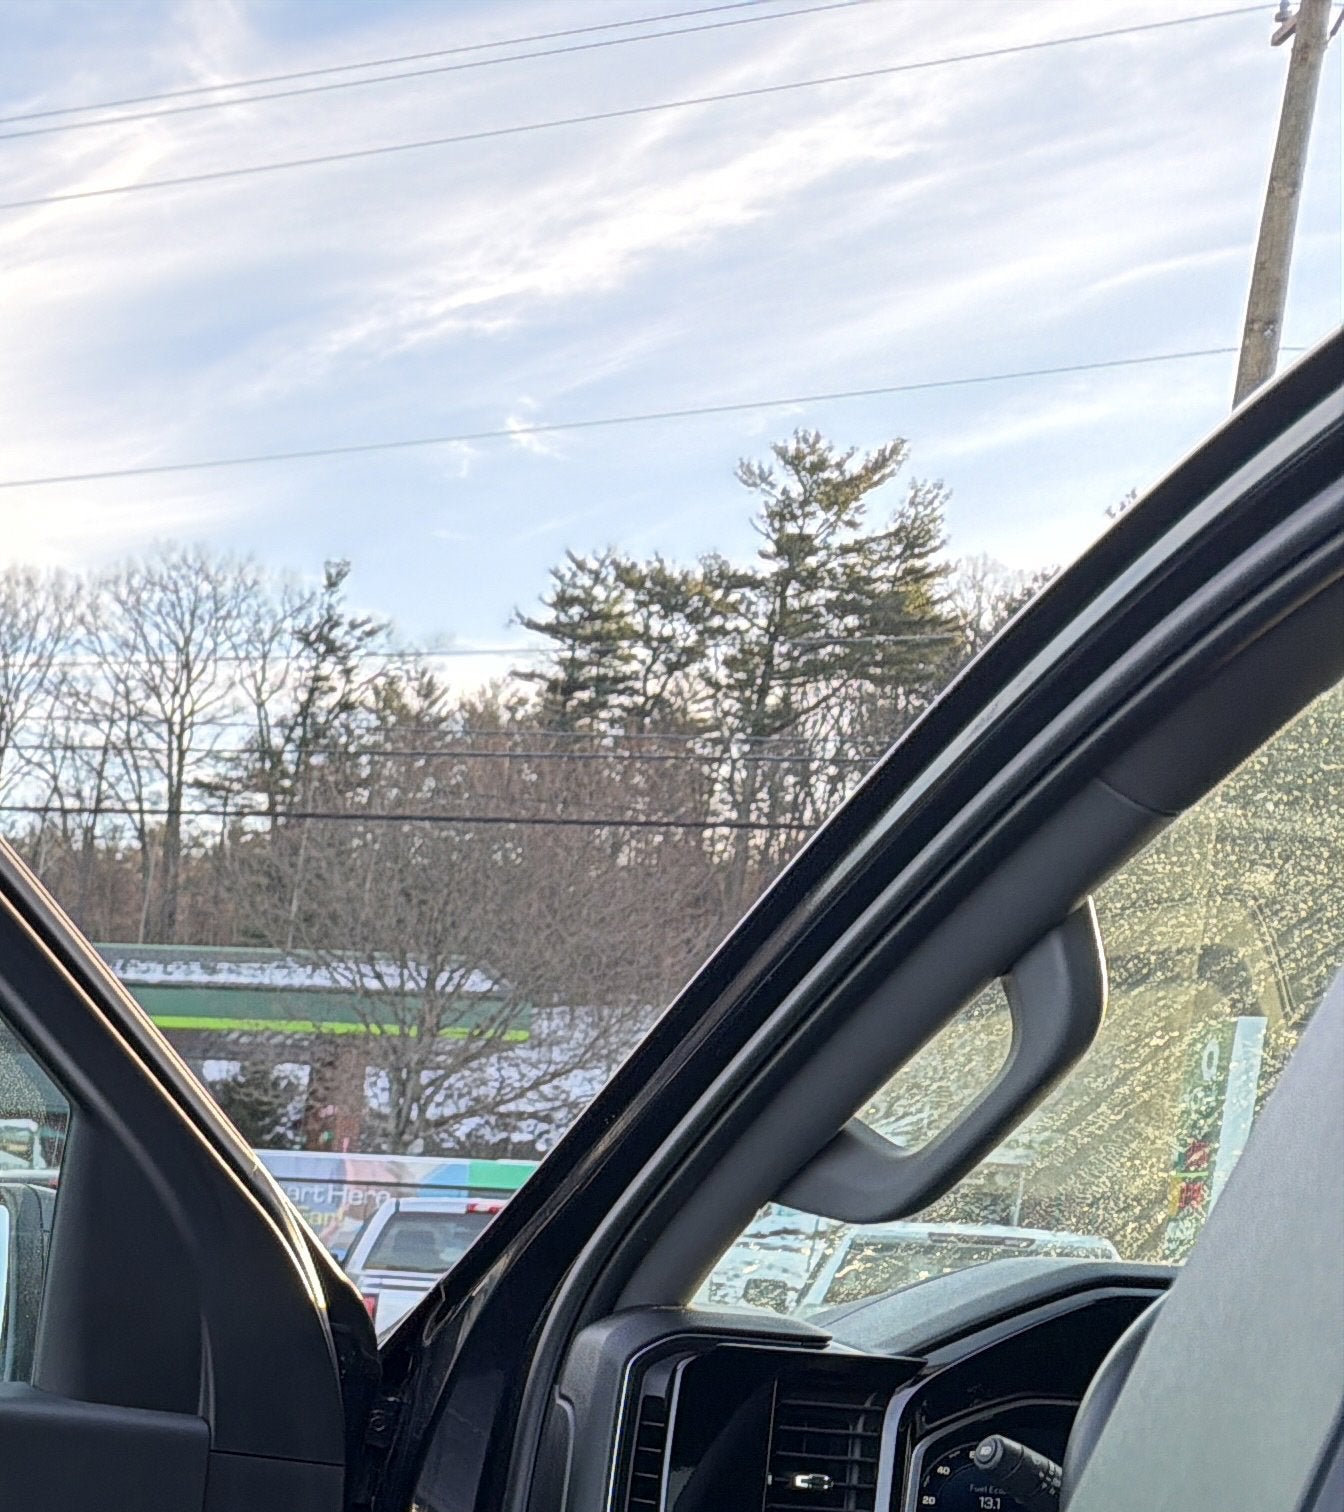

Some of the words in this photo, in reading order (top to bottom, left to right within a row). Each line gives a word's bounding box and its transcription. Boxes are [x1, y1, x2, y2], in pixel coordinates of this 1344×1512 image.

[286, 1183, 325, 1203] art
[327, 1183, 391, 1208] Here
[936, 1465, 951, 1476] 40
[922, 1495, 936, 1506] 20
[979, 1496, 1001, 1510] 13.1
